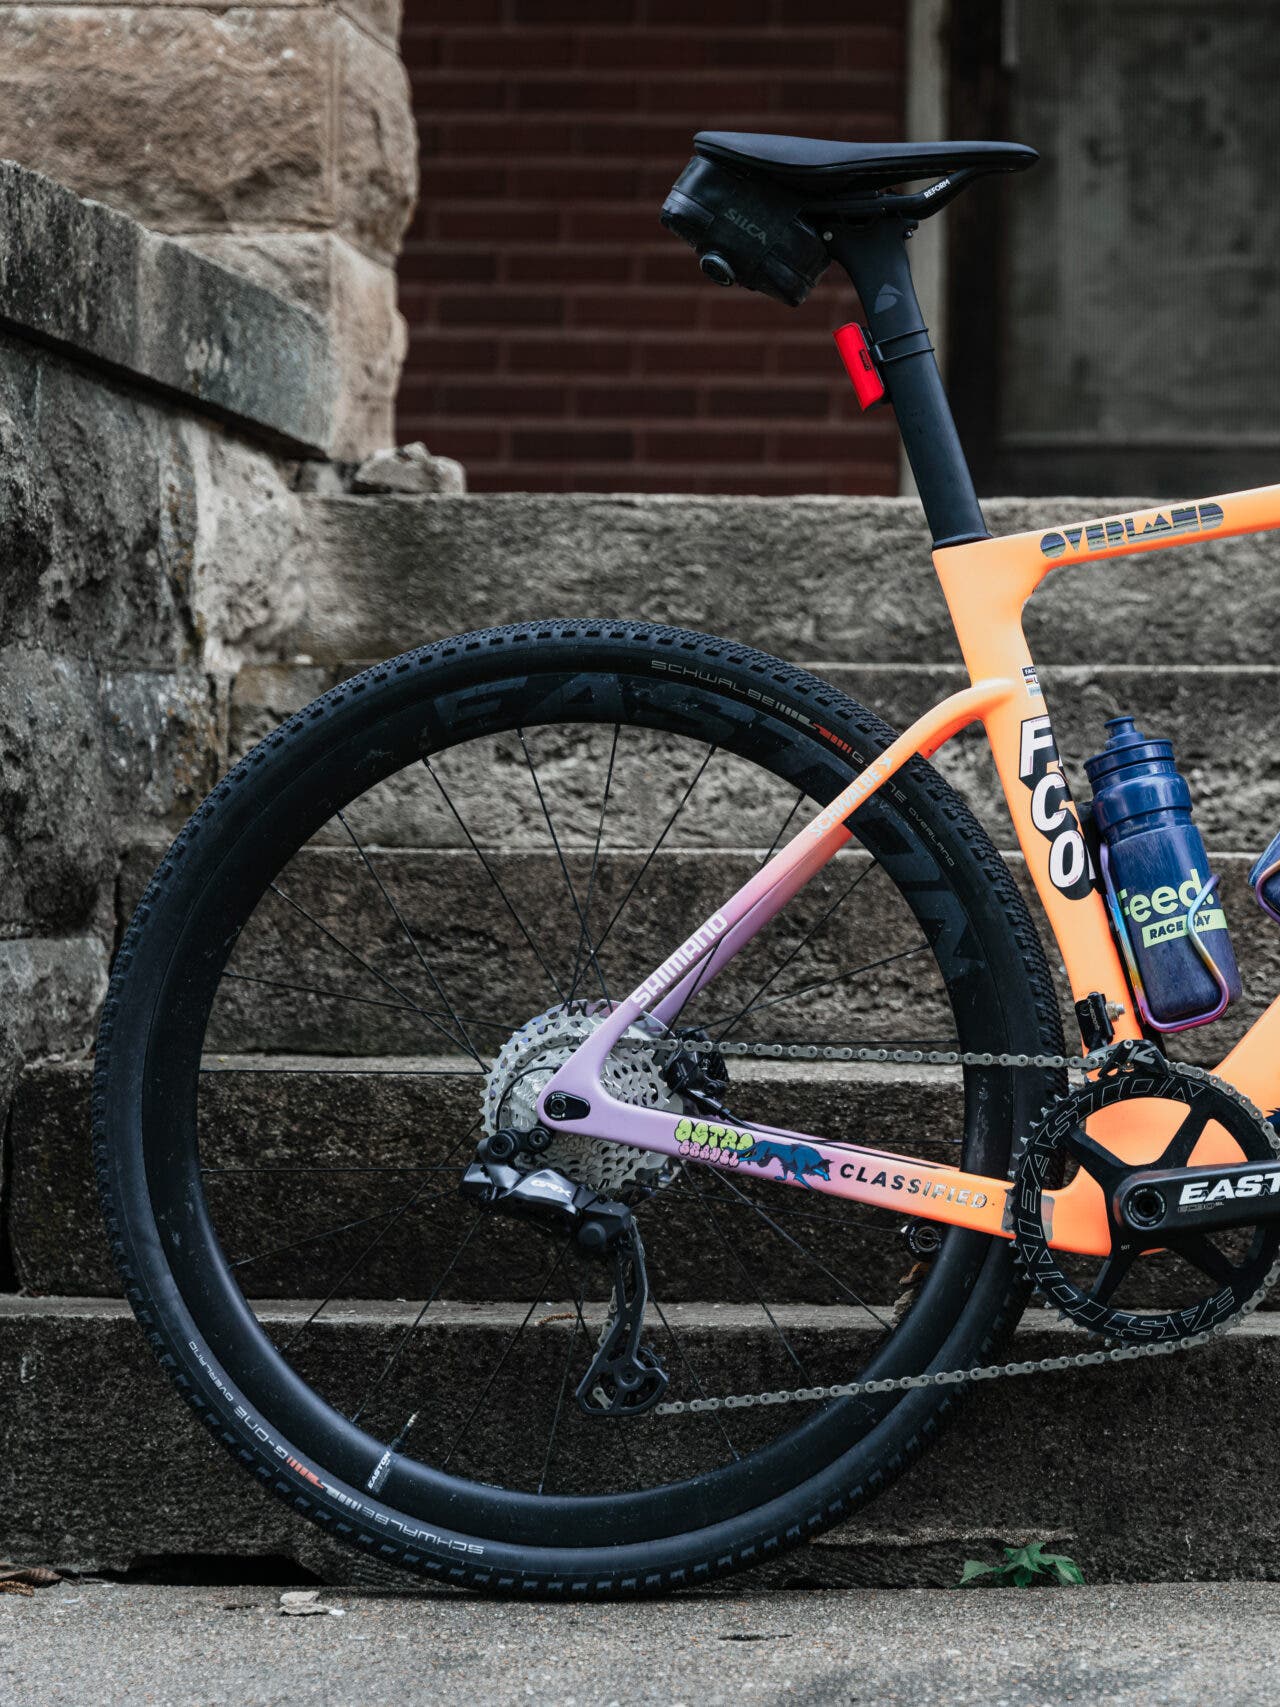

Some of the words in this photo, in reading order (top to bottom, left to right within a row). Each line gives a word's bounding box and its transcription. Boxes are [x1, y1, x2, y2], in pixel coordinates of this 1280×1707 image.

[923, 178, 951, 199] REFORM
[723, 207, 767, 246] SILCA
[651, 658, 777, 707] SCHWALBE
[908, 807, 955, 866] OVERLAND
[1149, 920, 1184, 940] RACE
[1193, 915, 1211, 928] AY
[628, 911, 729, 1009] SHIMANO
[839, 1163, 988, 1209] CLASSIFIED
[188, 1340, 234, 1402] OVERLAND
[233, 1406, 289, 1460] G-ONE
[366, 1450, 392, 1490] EASTON
[362, 1505, 486, 1555] SCHWALBE
